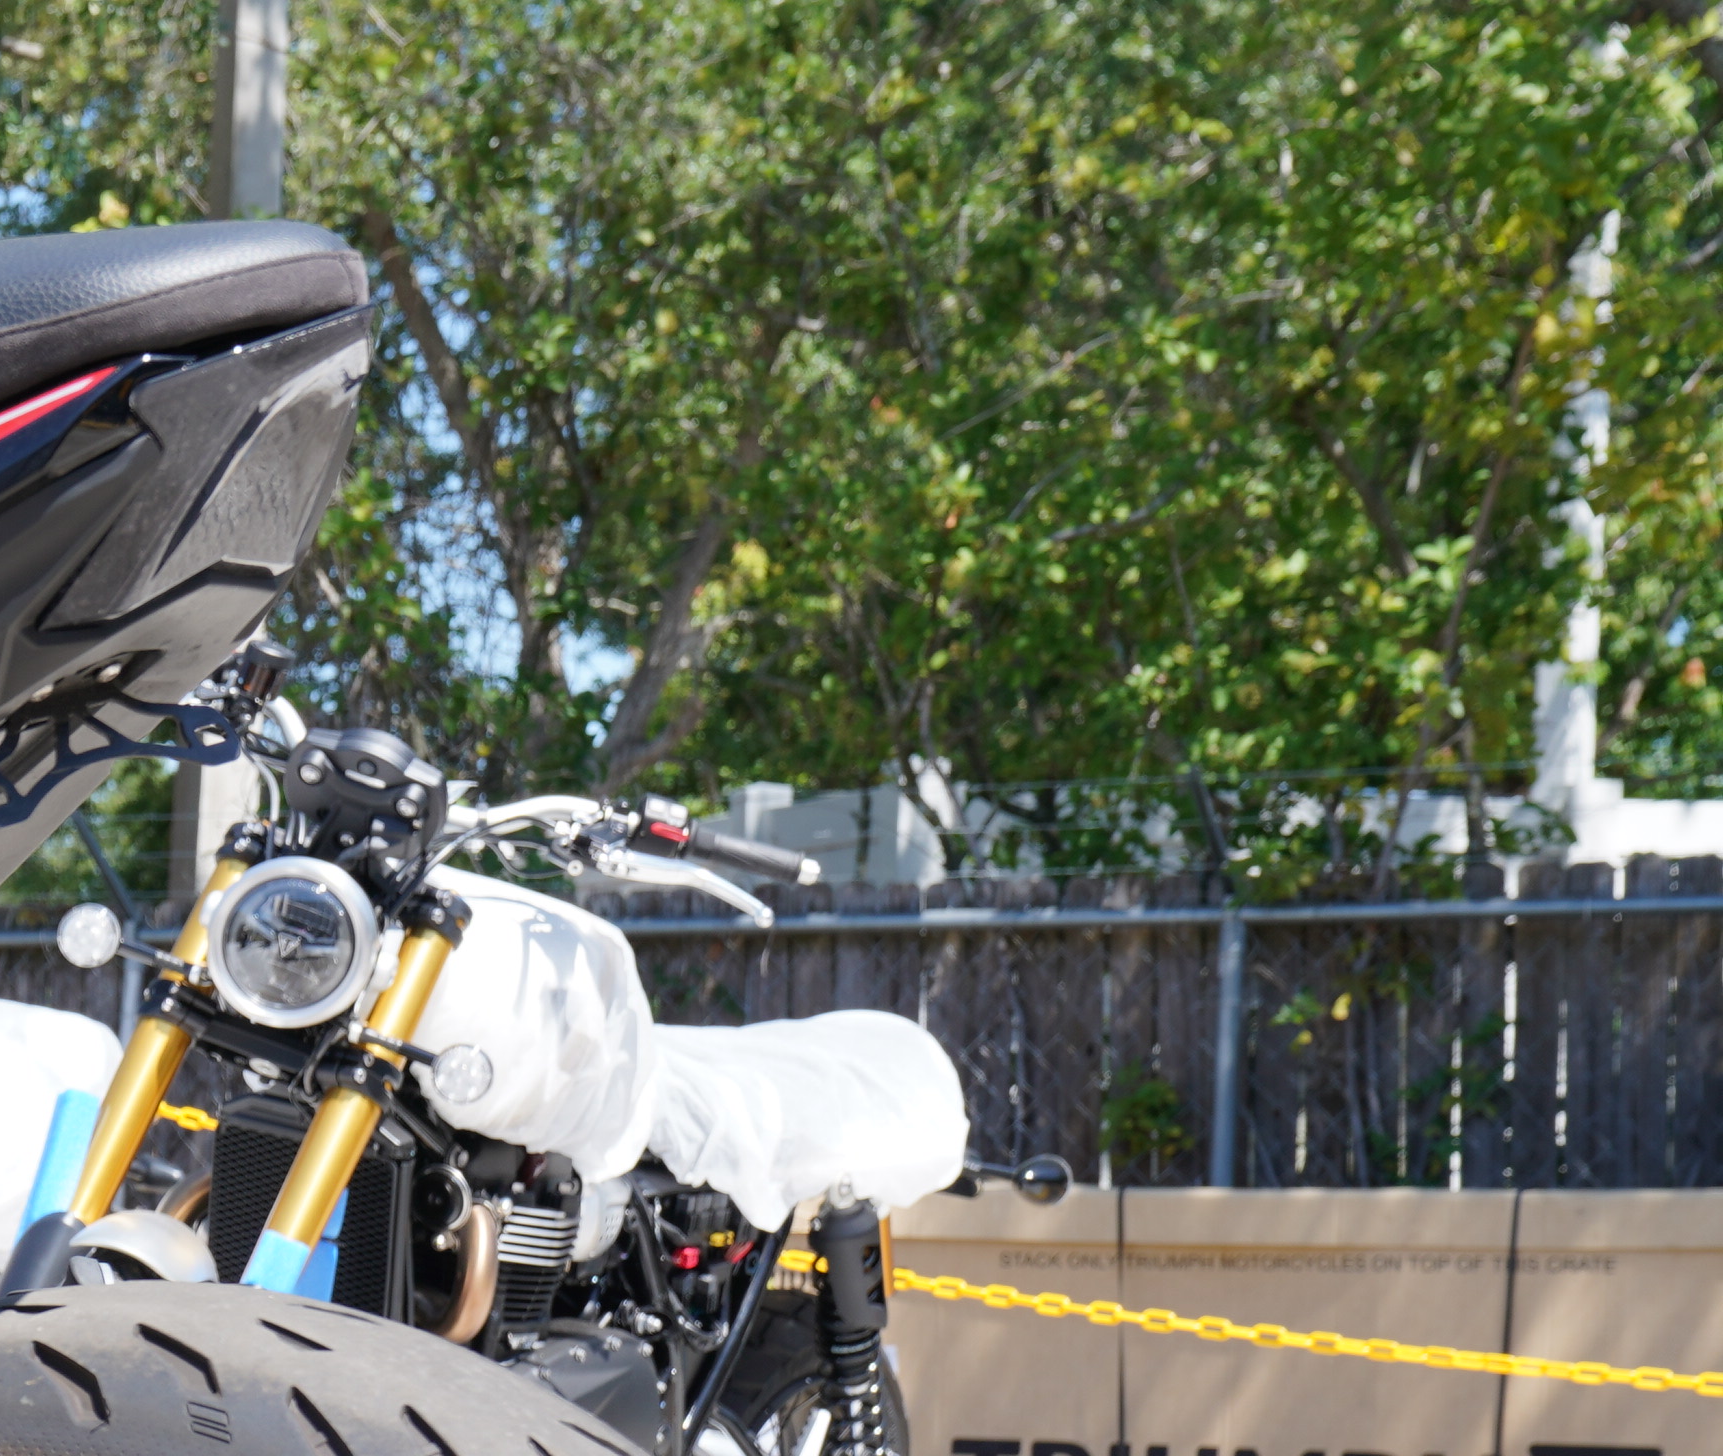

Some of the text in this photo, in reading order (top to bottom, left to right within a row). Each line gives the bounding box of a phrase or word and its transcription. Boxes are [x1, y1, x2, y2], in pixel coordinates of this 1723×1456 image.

[998, 1251, 1062, 1271] STACK
[1125, 1251, 1214, 1273] TRIUMPH
[1219, 1252, 1367, 1274] MOTORCYCLES
[1491, 1255, 1540, 1276] TIS
